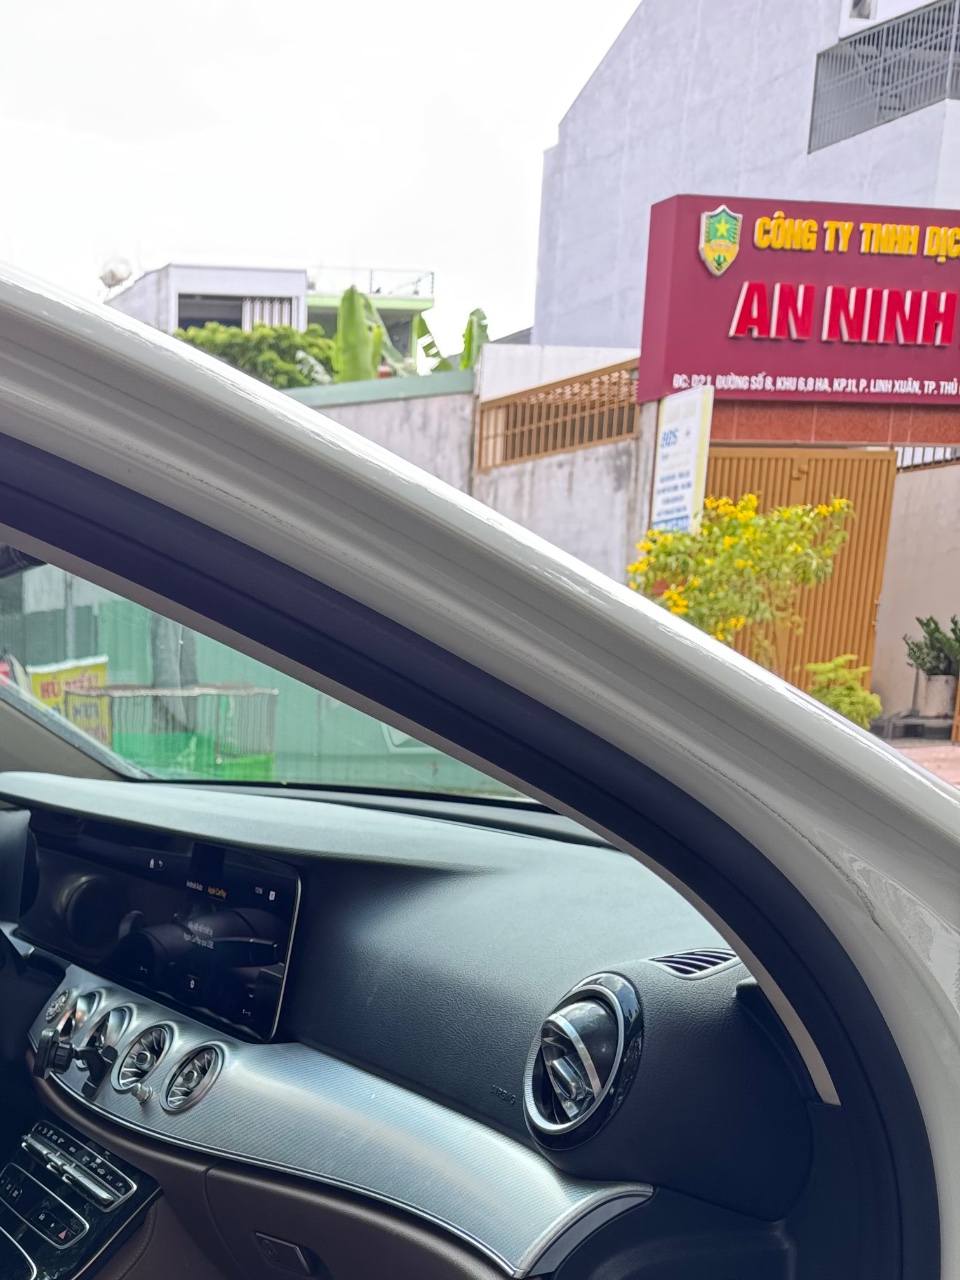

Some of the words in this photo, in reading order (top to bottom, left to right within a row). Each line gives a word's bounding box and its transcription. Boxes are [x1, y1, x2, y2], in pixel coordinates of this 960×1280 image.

[754, 211, 818, 251] CÔNG
[823, 220, 854, 253] TY
[859, 222, 920, 255] TNHH
[728, 281, 816, 340] AN
[821, 285, 958, 346] NINH
[870, 378, 893, 394] LINH
